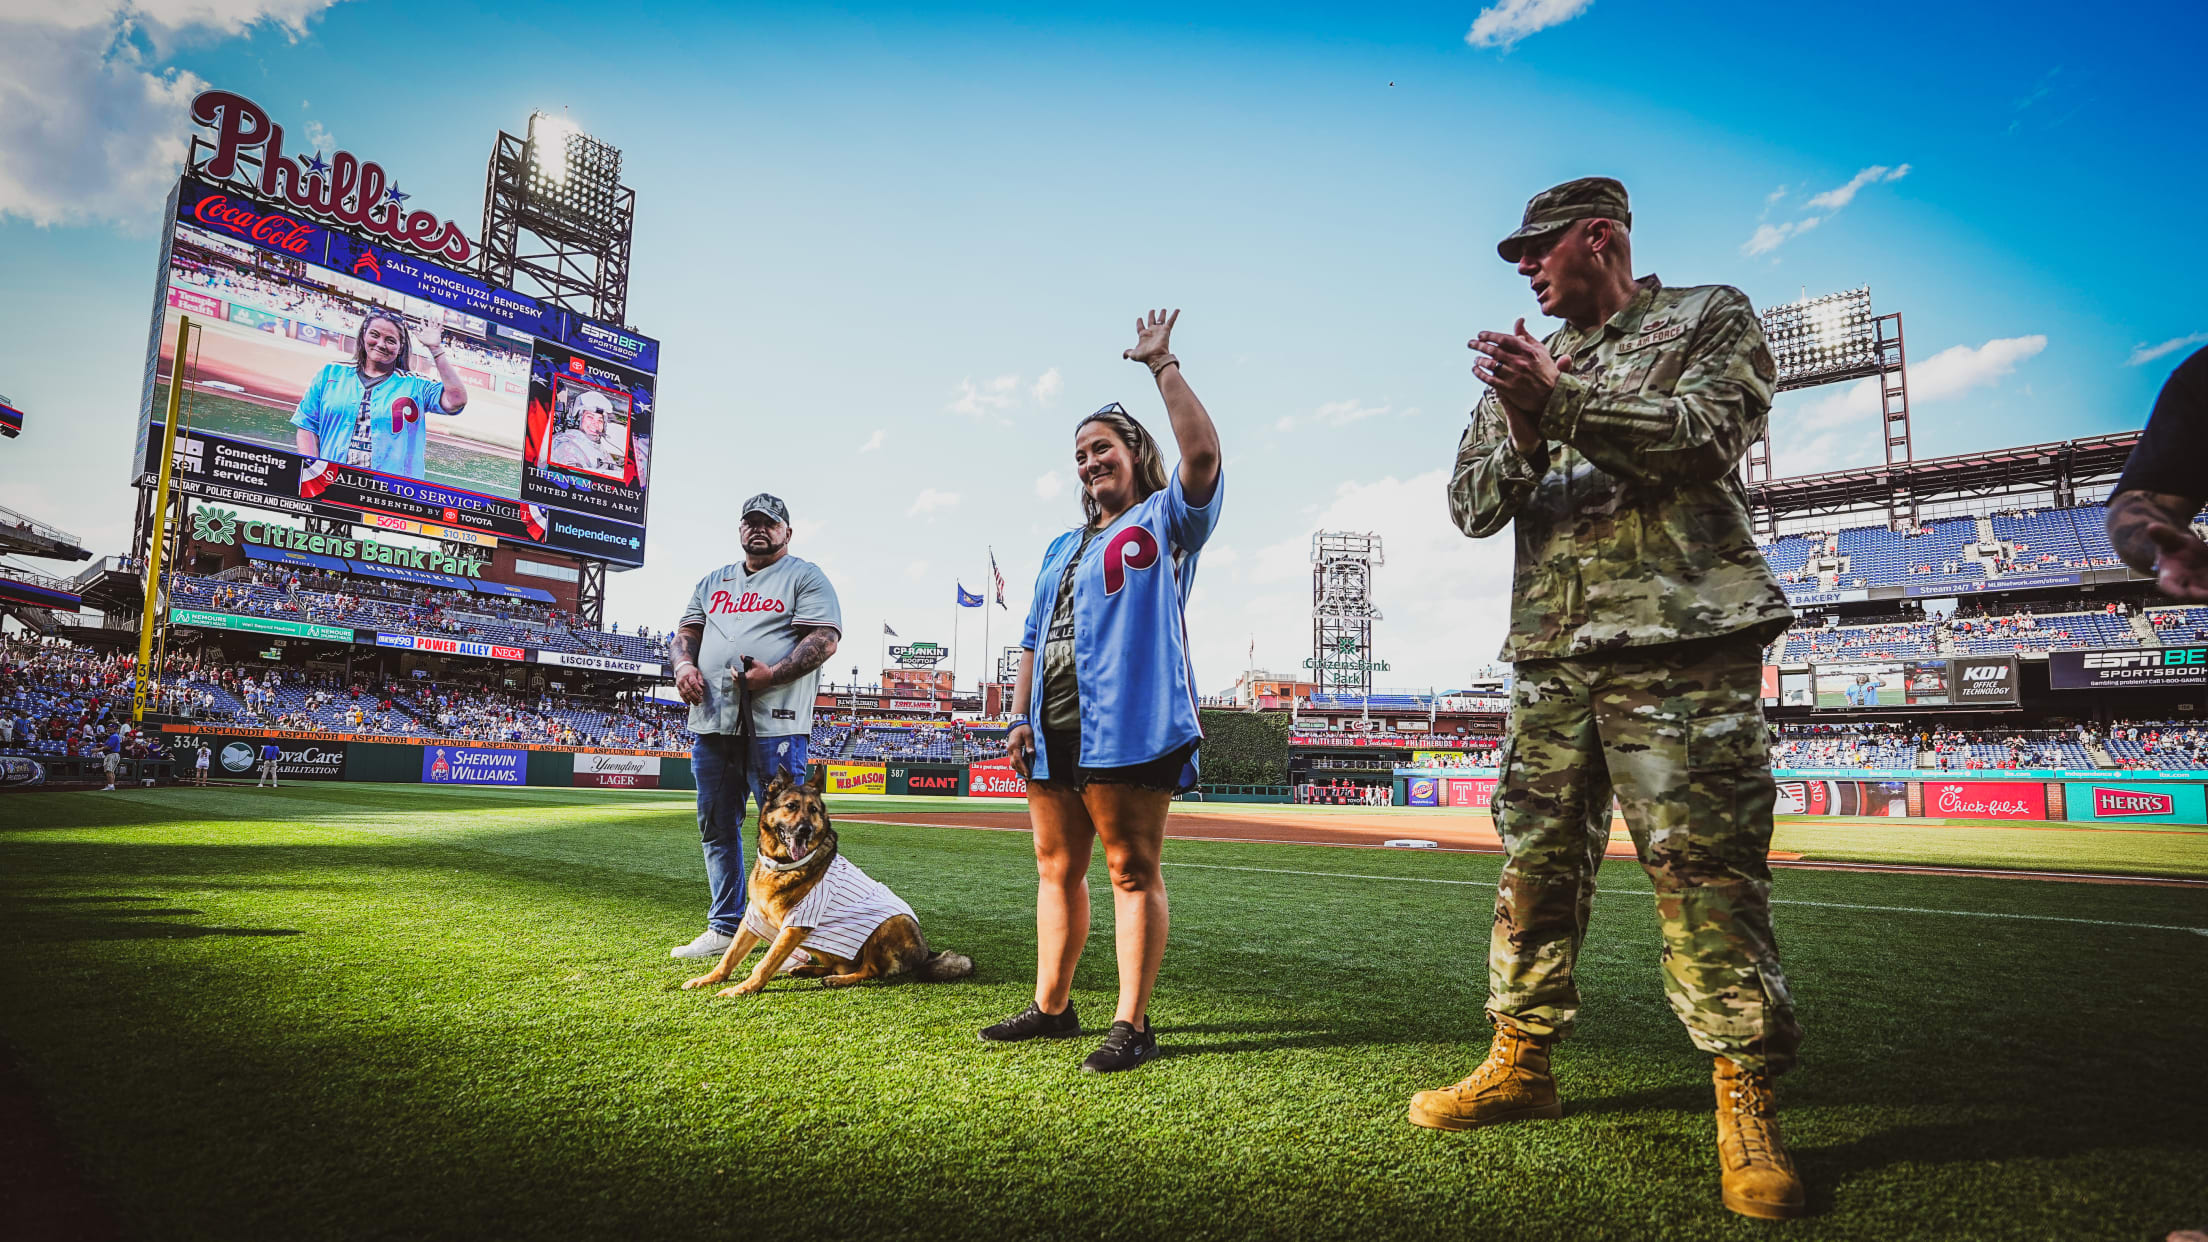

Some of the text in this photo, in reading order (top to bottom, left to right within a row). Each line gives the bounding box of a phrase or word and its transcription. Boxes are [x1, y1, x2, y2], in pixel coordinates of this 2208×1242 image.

[190, 89, 472, 263] Phillies
[194, 195, 317, 254] Coca-Cola
[386, 259, 543, 320] SALTZ MONGELUZZI BENDESKY
[418, 281, 515, 320] INJURY LAWYERS
[581, 322, 618, 344] ESPN
[618, 335, 647, 353] BET
[1636, 337, 1651, 348] AIR
[1653, 327, 1681, 342] FORCE
[587, 337, 639, 358] SPORTSBOOK
[587, 365, 622, 382] TOYOTA
[214, 455, 270, 476] financial
[216, 444, 287, 470] Connecting
[212, 468, 268, 487] services.
[527, 466, 578, 486] TIFFANY
[145, 474, 157, 485] AS
[206, 485, 232, 498] POLICE
[233, 490, 263, 504] OFFICER
[263, 497, 279, 507] AND
[279, 500, 314, 513] CHEMICAL
[325, 470, 530, 521] SALUTE TO SERVICE NIGHT
[528, 482, 640, 514] UNITED STATES ARMY
[359, 494, 493, 527] PRESENTED BY TOYOTA
[443, 529, 477, 543] $10,130
[555, 521, 628, 546] Independence
[243, 520, 482, 579] Citizens Bank Park
[365, 564, 413, 577] HARRY
[1919, 586, 1952, 594] Stream
[1953, 584, 1969, 592] 24/7
[708, 590, 785, 614] Phillies
[1796, 593, 1841, 604] BAKERY
[191, 613, 227, 623] NEMOURS
[417, 637, 490, 656] POWER ALLEY
[494, 647, 524, 659] NECA
[561, 655, 641, 672] LISCIO'S BAKERY
[1305, 657, 1388, 671] Citizens Bank
[2083, 648, 2208, 669] ESPN BE
[1333, 672, 1360, 685] Park
[1972, 681, 1998, 689] OFFICE
[1962, 687, 2010, 696] TECHNOLOGY
[197, 726, 264, 737] ASPLUNDH
[276, 730, 339, 741] ASPLUNDH
[350, 734, 408, 744] ASPLUNDH
[173, 735, 200, 749] 334
[418, 738, 471, 747] ASPLUNDH
[480, 741, 530, 750] ASPLUNDH
[539, 744, 586, 753] ASPLUNDH
[454, 750, 517, 767] SHERWIN
[593, 747, 636, 756] ASPLUNDH
[644, 750, 684, 758] ASPLUNDH
[590, 755, 645, 773] Yuengling
[599, 775, 635, 786] LAGER
[908, 776, 958, 789] GIANT
[1938, 785, 2030, 815] Chick-fil-A
[2100, 795, 2165, 811] HERR'S
